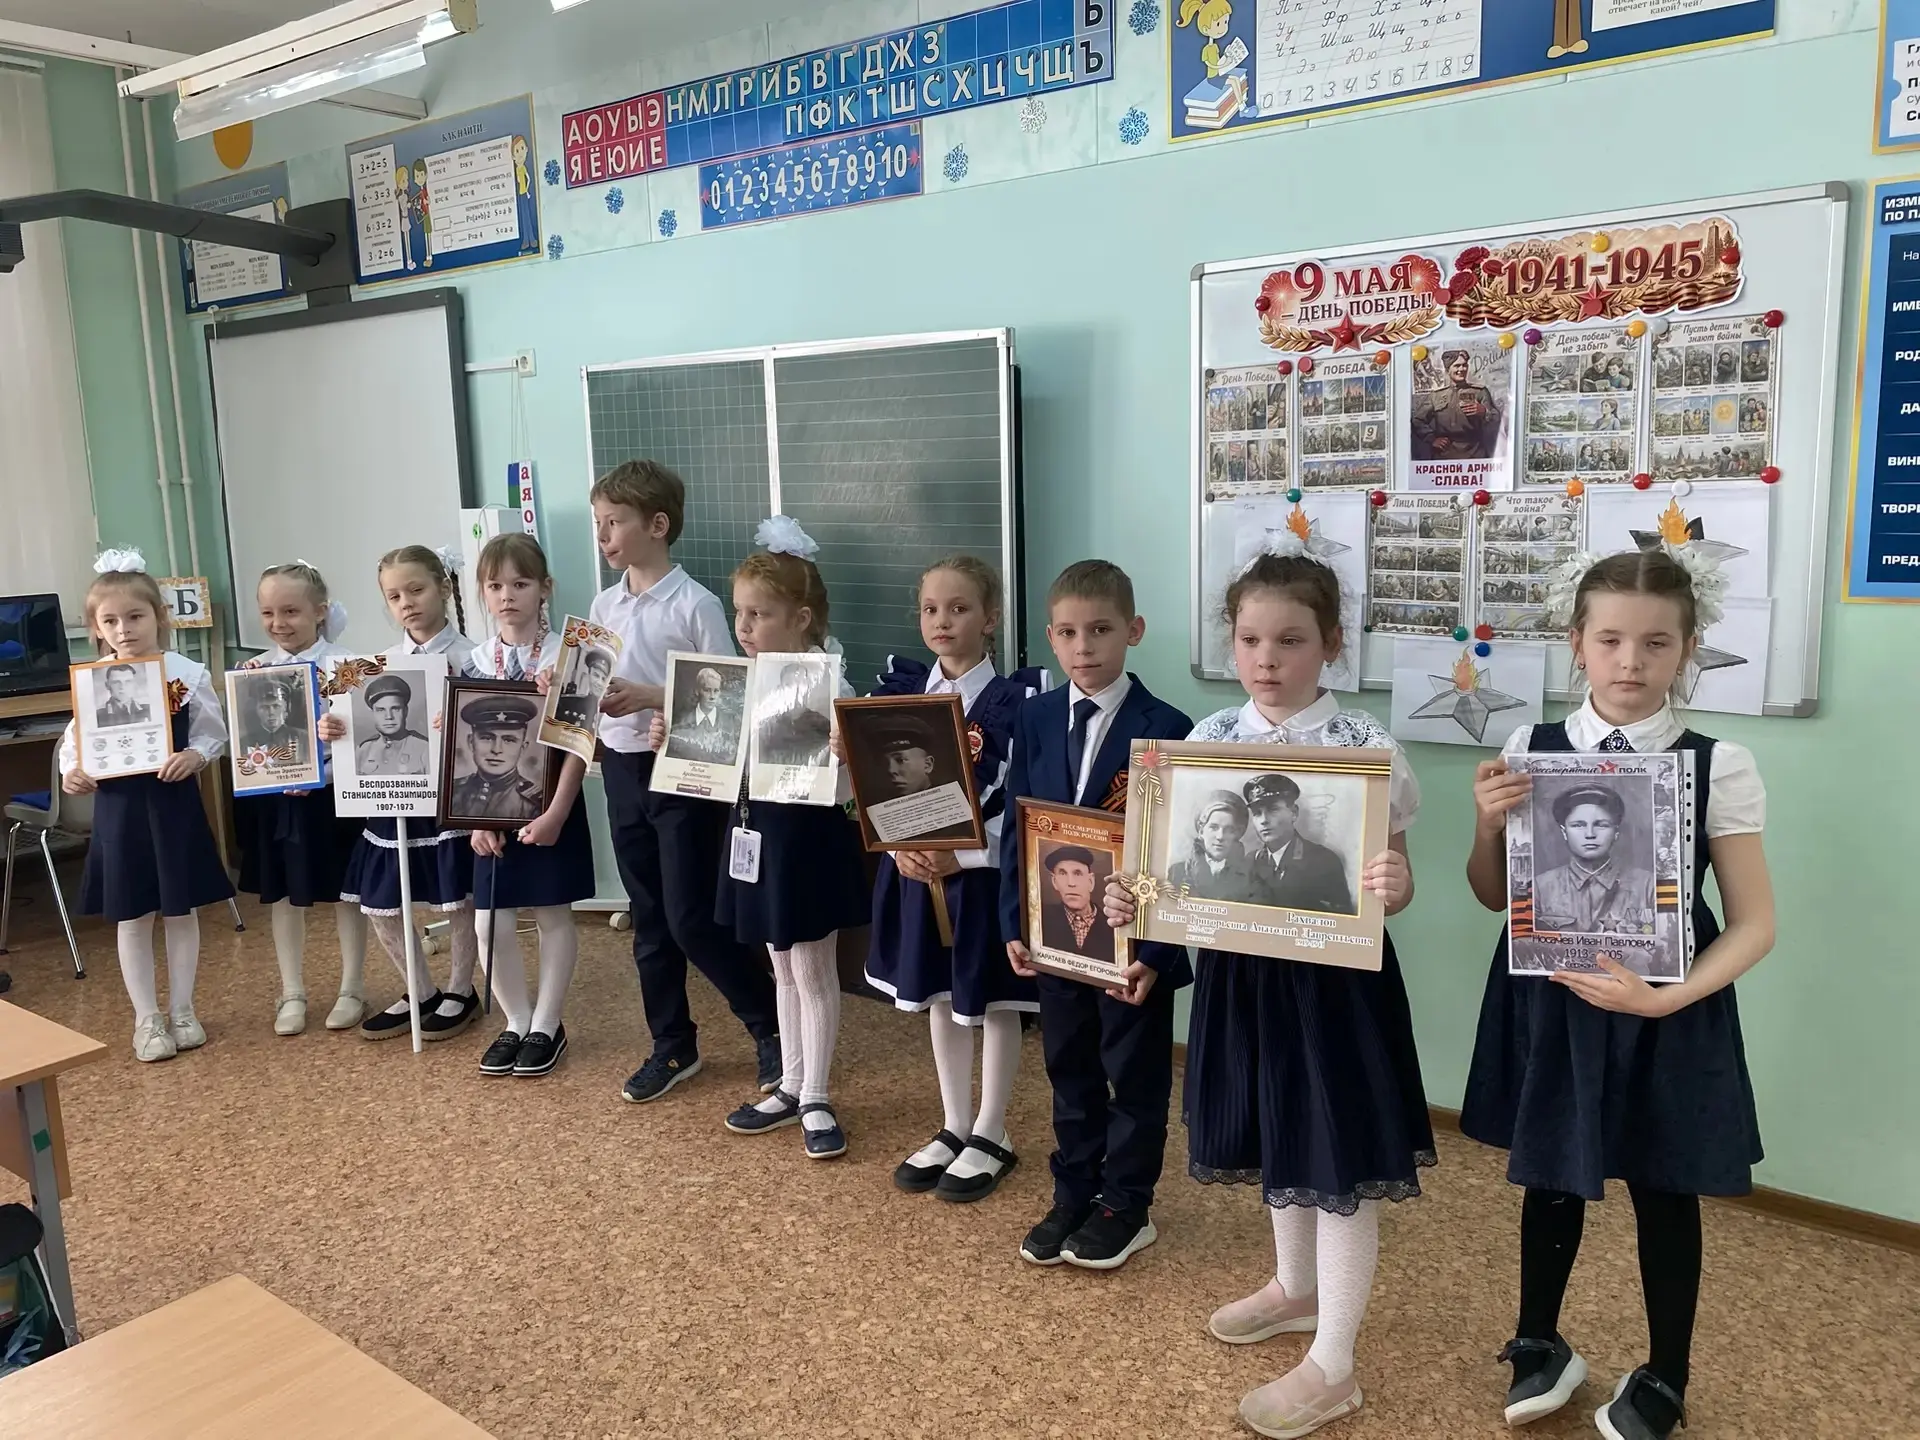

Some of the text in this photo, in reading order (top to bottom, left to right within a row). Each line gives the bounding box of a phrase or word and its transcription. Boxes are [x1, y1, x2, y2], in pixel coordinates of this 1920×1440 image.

[1608, 2, 1647, 15] отвечает
[1650, 1, 1680, 15] какой?
[1263, 54, 1474, 109] 0 1 2 3 4 5 6 7 8 9
[1885, 196, 1920, 209] ИЗМ
[1884, 210, 1904, 222] ПО
[1503, 240, 1704, 297] 1941-1945
[1294, 262, 1412, 302] 9 МАЯ
[1298, 293, 1432, 323] ДЕНЬ ПОБЕДЫ!
[1683, 321, 1743, 336] Пусть дети не
[1556, 332, 1611, 347] День победы
[1687, 331, 1742, 344] знают войны
[1562, 341, 1609, 354] не забыть
[1323, 362, 1366, 376] ПОБЕДА
[1221, 371, 1277, 386] День Победы
[1887, 456, 1920, 466] ВИН
[521, 466, 530, 480] а
[1415, 462, 1463, 475] КРАСНОЙ
[521, 487, 532, 501] я
[1506, 496, 1553, 505] Что такое
[1513, 504, 1546, 513] война?
[1881, 504, 1920, 514] ТВОР
[524, 510, 534, 523] о
[1882, 555, 1920, 567] ПРЕД
[359, 778, 428, 789] Беспрозванный
[342, 790, 439, 799] Станислав Казимиров
[376, 803, 414, 811] 1907-1973
[1061, 822, 1109, 836] БЕССМЕРТНЫЙ
[1063, 829, 1108, 842] ПОЛК РОССИИ
[1533, 934, 1656, 948] Носачев Иван Павлович
[1565, 948, 1589, 959] 1913
[1037, 951, 1067, 965] КАРАТАЕВ
[1067, 960, 1089, 970] ФЕДОР
